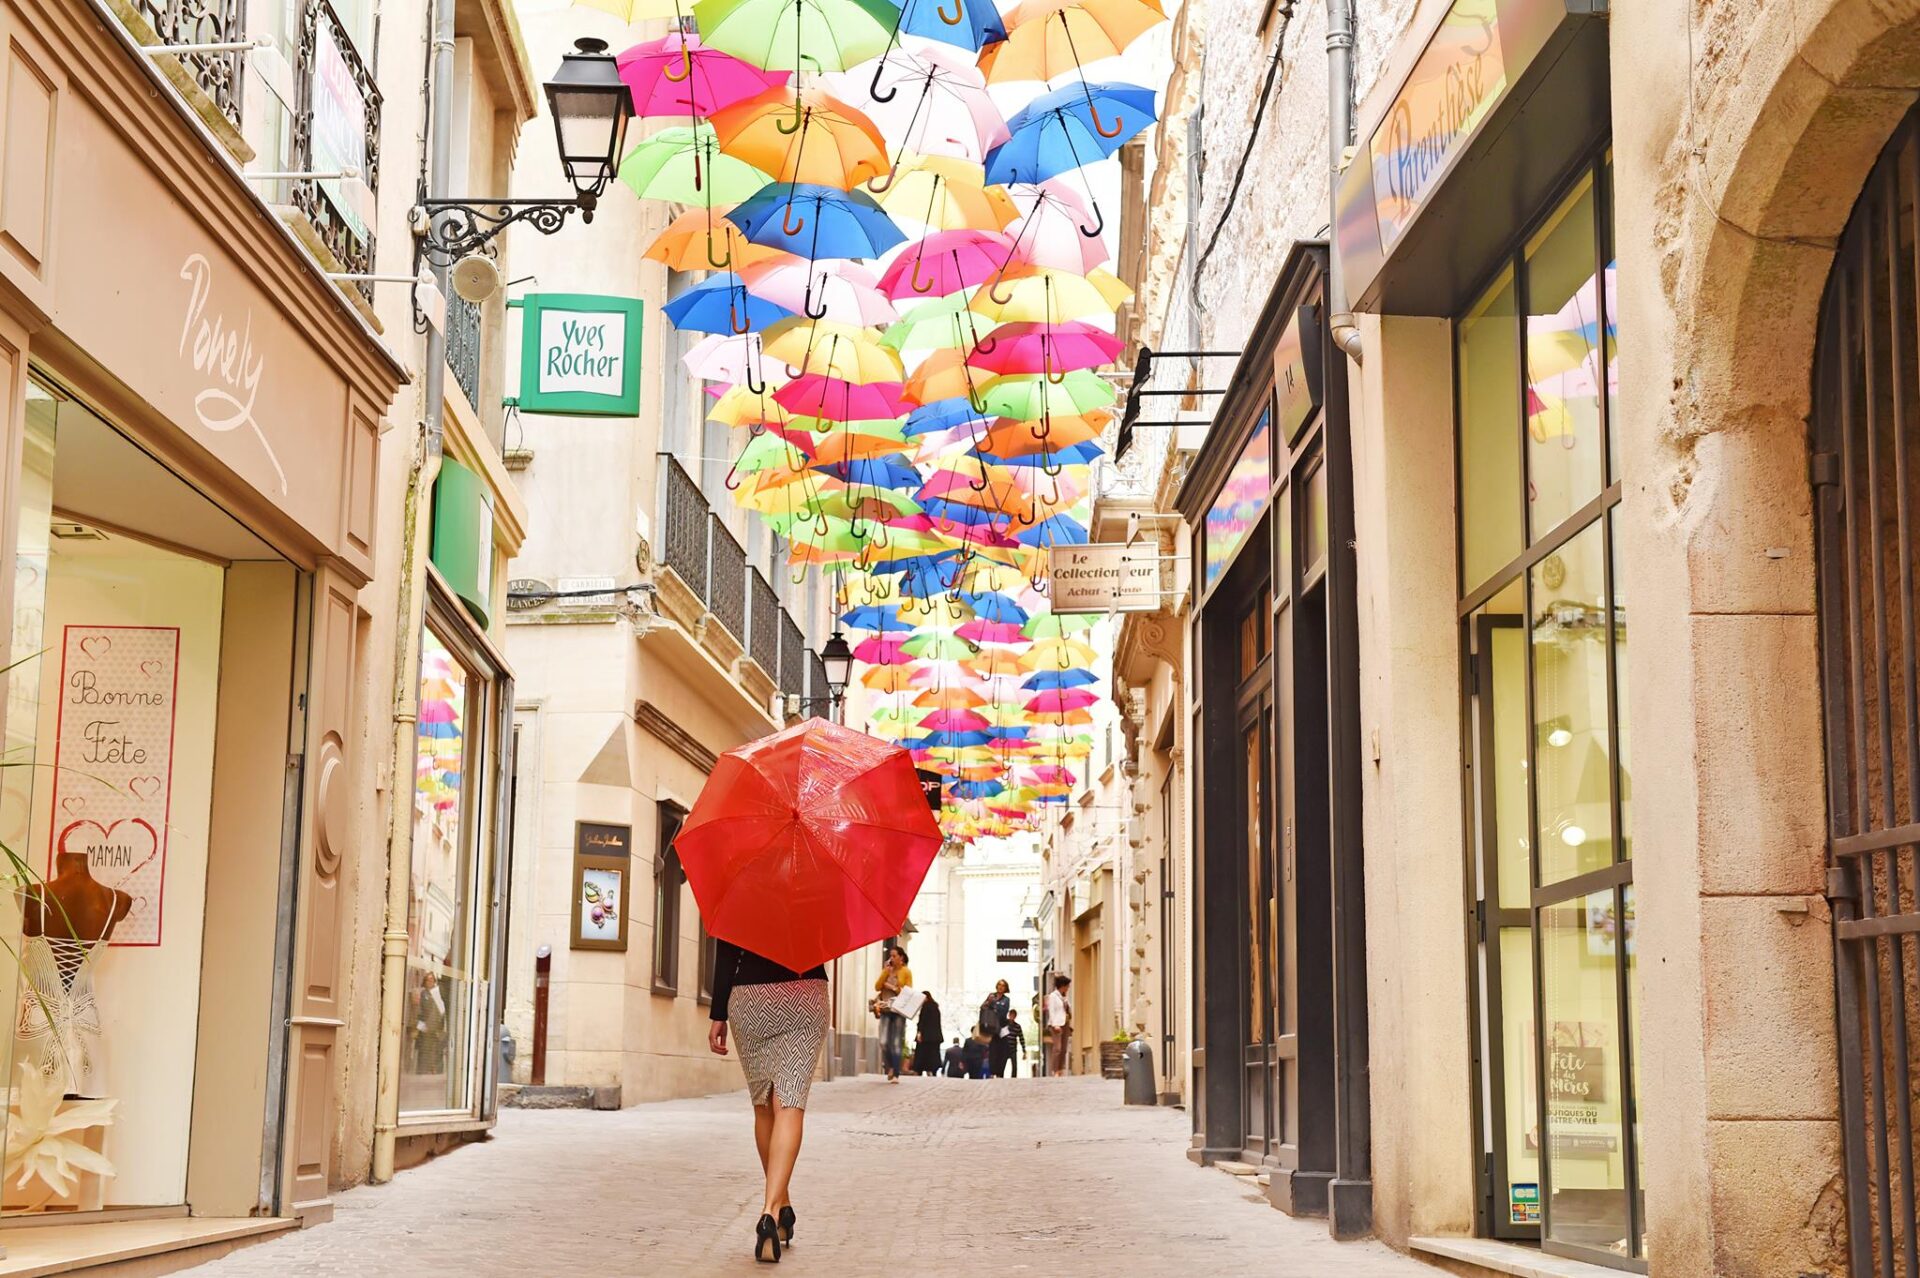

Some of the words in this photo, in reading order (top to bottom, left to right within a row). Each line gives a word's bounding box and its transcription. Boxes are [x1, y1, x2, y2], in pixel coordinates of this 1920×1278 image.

[562, 320, 605, 352] Yves
[547, 346, 619, 377] Rocher
[1072, 553, 1089, 565] Le
[1053, 567, 1154, 579] Collectioneur
[511, 580, 534, 591] RUE
[1067, 587, 1100, 596] Achat
[71, 670, 164, 705] Bonne
[82, 720, 148, 765] Fête
[86, 844, 132, 868] MAMAN
[996, 948, 1028, 957] INTIMO
[1550, 1051, 1586, 1073] Fête
[1586, 1110, 1598, 1118] DU
